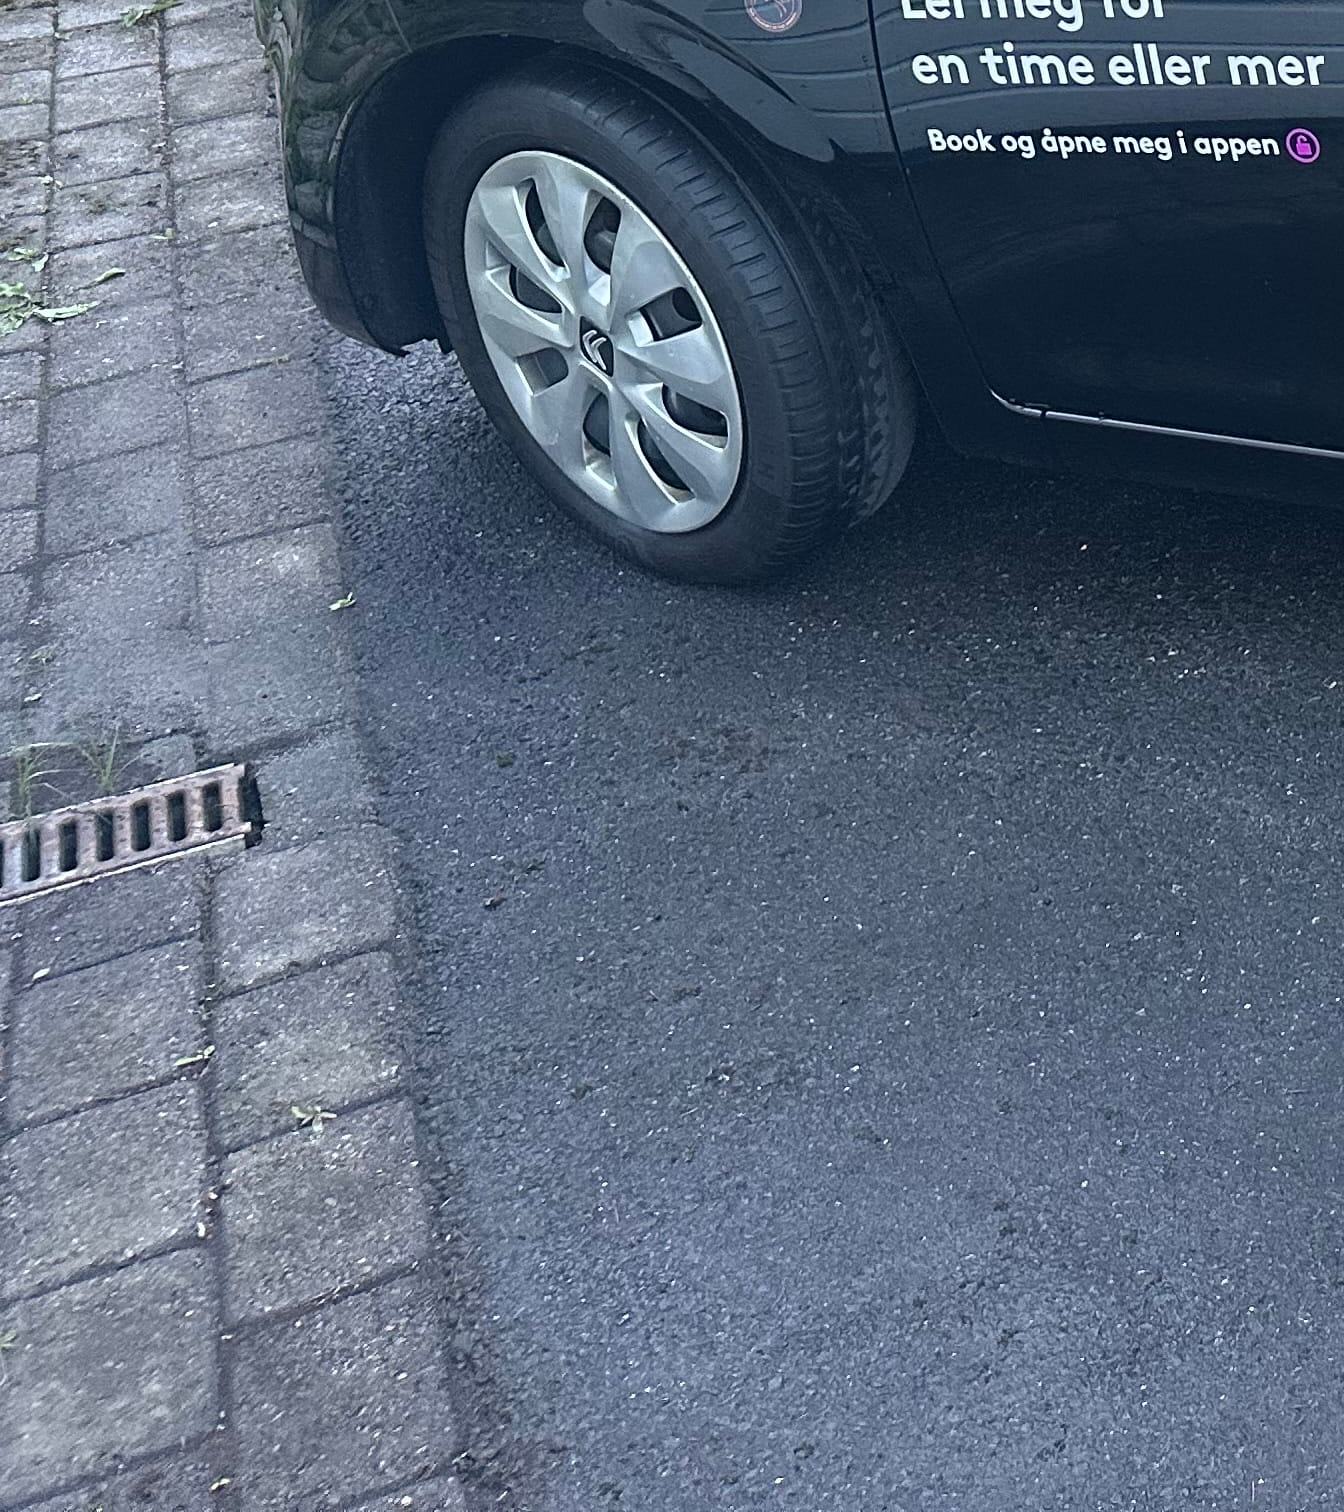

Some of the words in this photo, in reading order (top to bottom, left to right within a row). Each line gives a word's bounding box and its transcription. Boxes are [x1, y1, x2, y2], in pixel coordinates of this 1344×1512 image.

[911, 54, 970, 85] en
[980, 41, 1095, 86] time
[1108, 43, 1211, 86] eller
[1227, 55, 1325, 86] mer
[927, 128, 997, 153] Book
[1001, 135, 1036, 160] og
[1041, 127, 1107, 161] åpne
[1112, 136, 1173, 161] meg
[1176, 129, 1188, 154] i
[1193, 137, 1280, 163] appen
